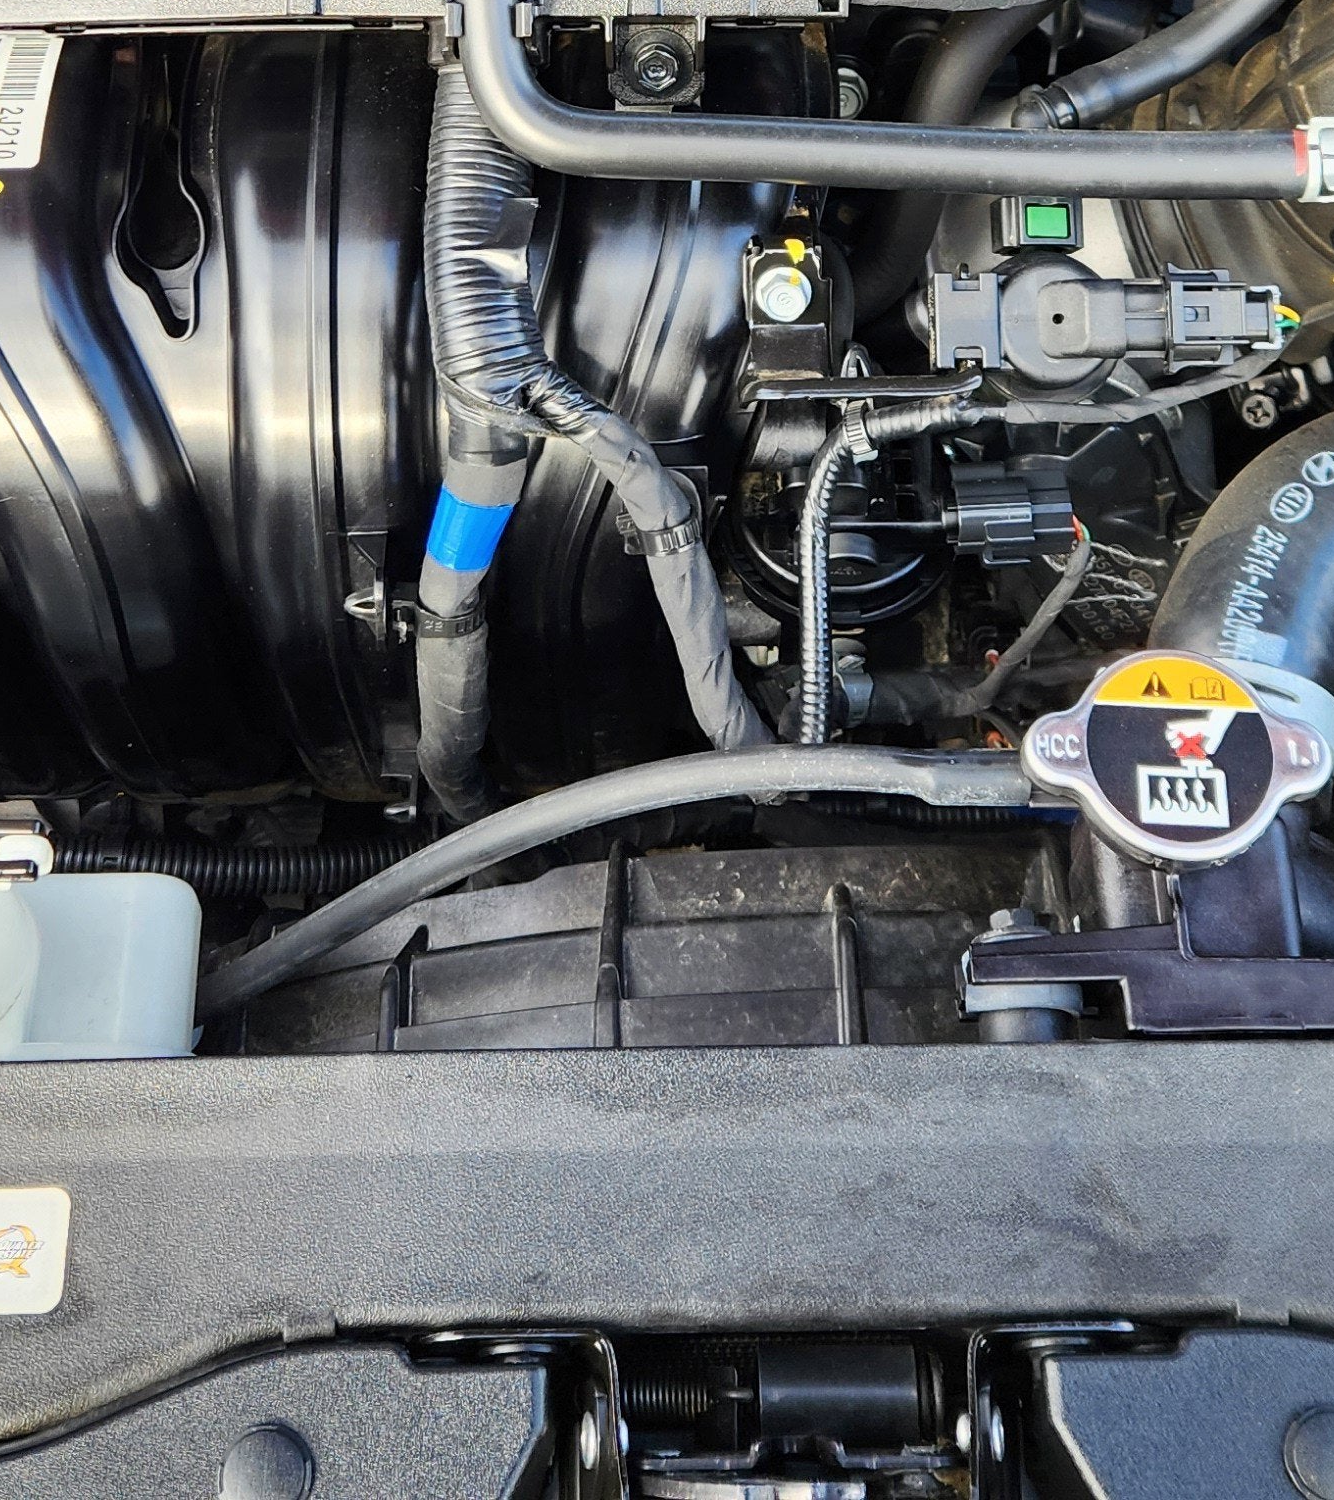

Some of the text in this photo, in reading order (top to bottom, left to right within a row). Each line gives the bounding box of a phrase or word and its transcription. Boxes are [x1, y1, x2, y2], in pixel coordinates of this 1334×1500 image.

[1272, 485, 1310, 520] KIA
[1036, 733, 1320, 767] HCC 1.1
